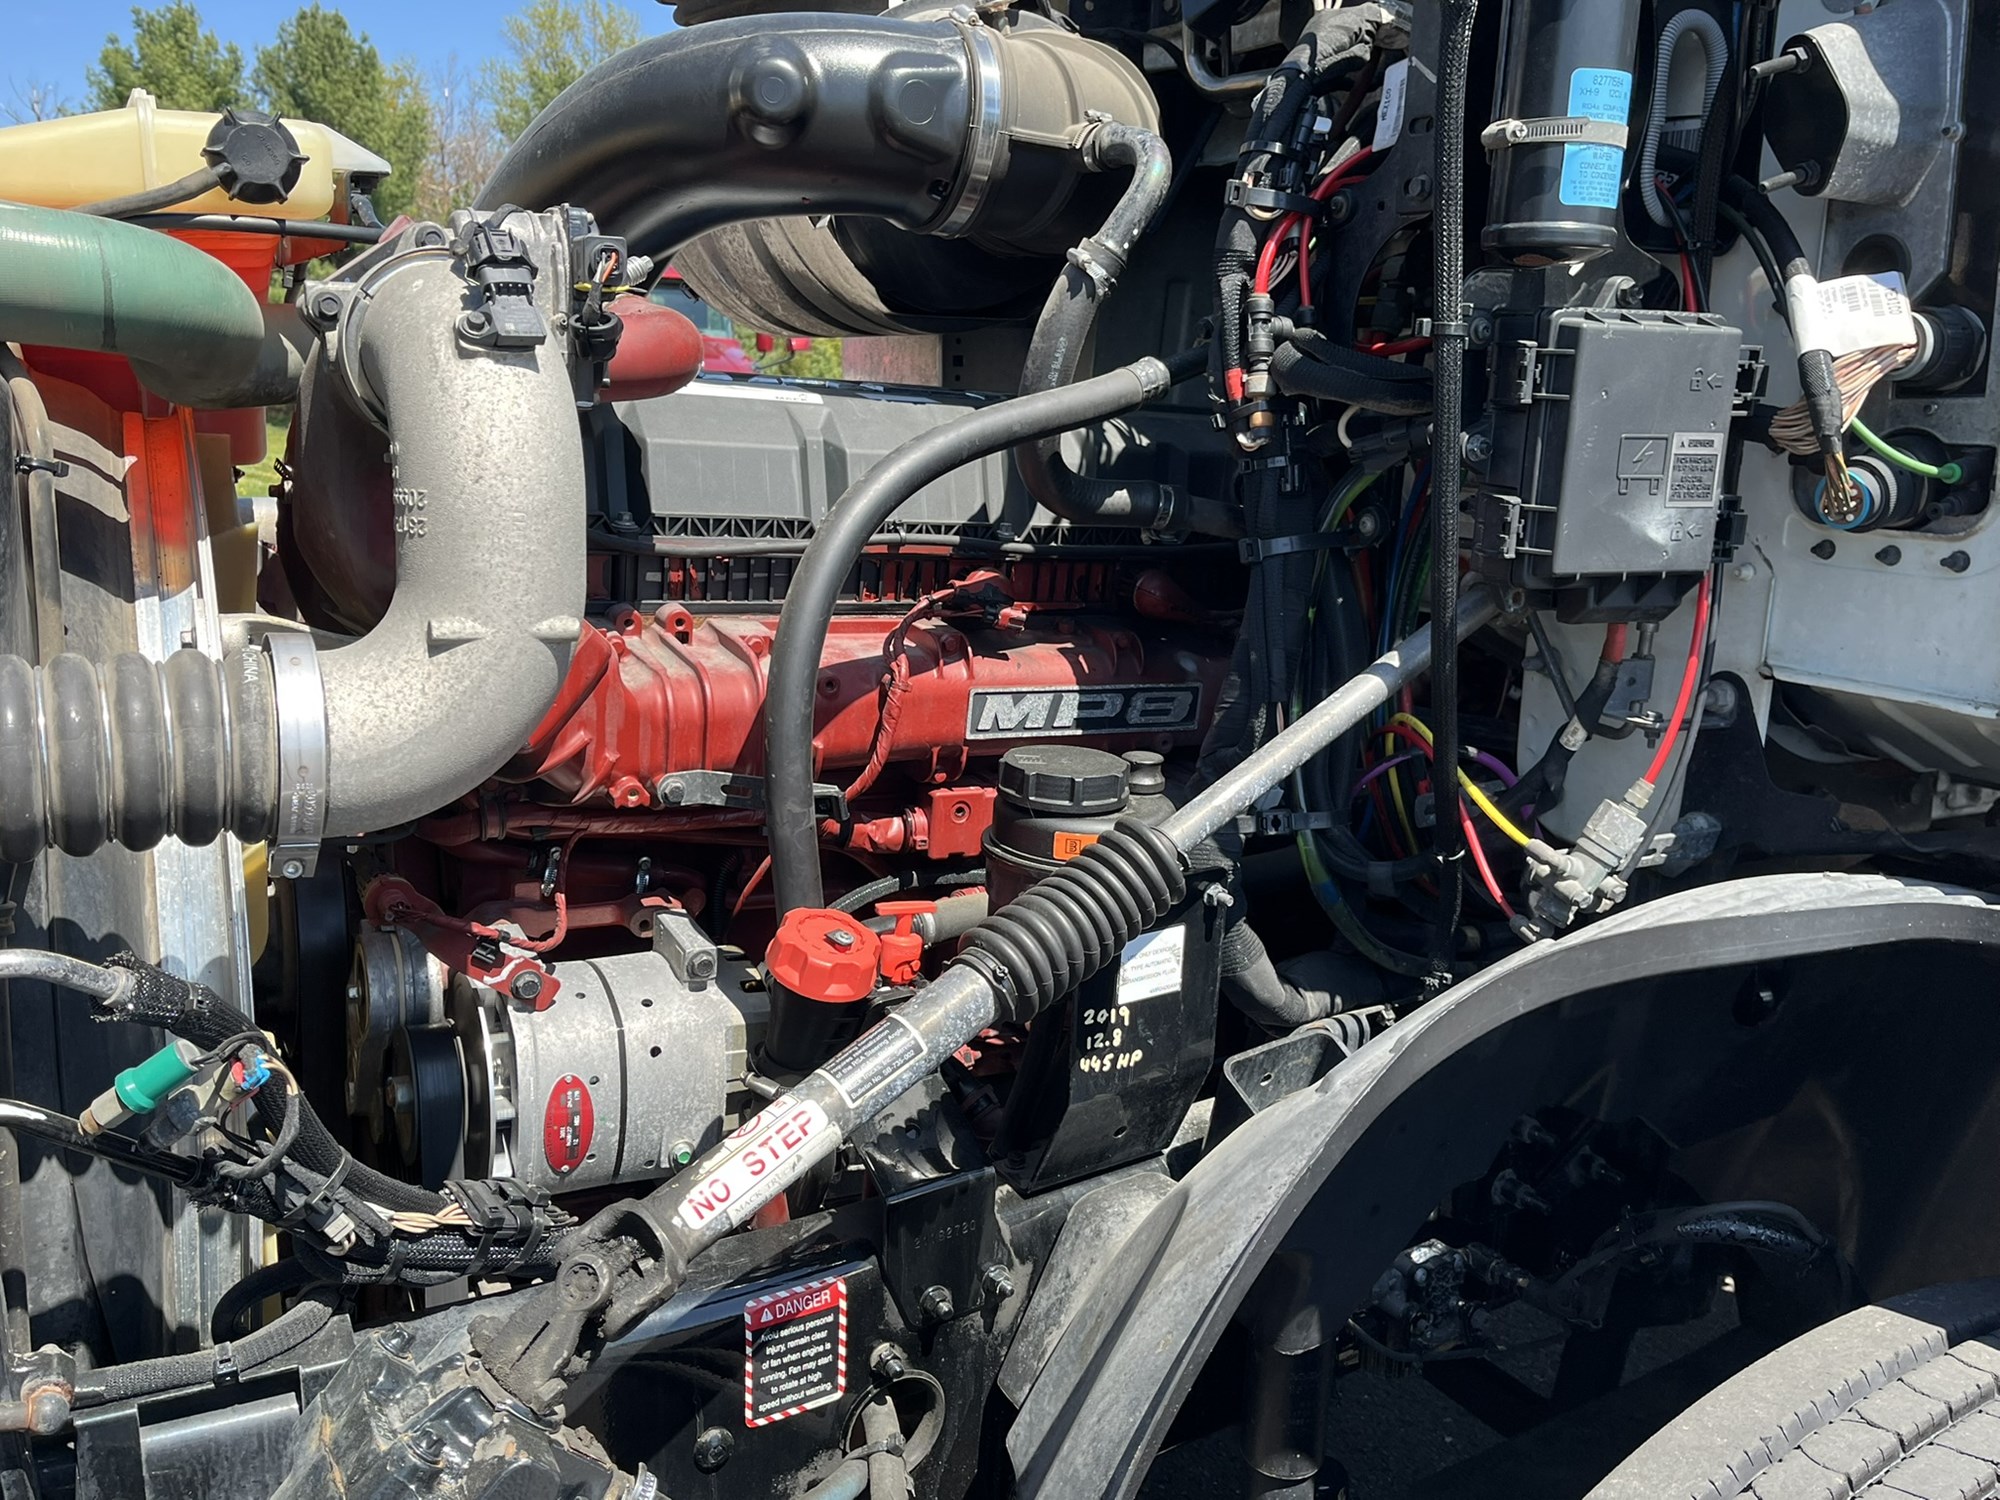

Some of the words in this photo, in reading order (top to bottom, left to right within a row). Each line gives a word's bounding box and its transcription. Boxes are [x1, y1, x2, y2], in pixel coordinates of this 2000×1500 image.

[1381, 88, 1392, 121] MEXICO
[1579, 170, 1588, 178] TO
[242, 651, 259, 683] CHINA
[976, 691, 1193, 732] MP8
[1083, 1005, 1130, 1026] 2019
[841, 1063, 852, 1074] the
[864, 1037, 889, 1058] Steering
[886, 1025, 904, 1041] Angle
[1086, 1028, 1122, 1050] 12.8
[1080, 1052, 1114, 1073] 445
[1116, 1049, 1143, 1070] HP
[849, 1080, 873, 1099] Bulletin
[871, 1073, 882, 1083] No.
[688, 1179, 731, 1220] NO
[742, 1110, 811, 1176] STEP
[731, 1187, 764, 1214] MACK
[776, 1290, 831, 1318] DANGER
[780, 1323, 804, 1337] serious
[805, 1313, 834, 1331] personal
[762, 1360, 769, 1370] of
[770, 1358, 781, 1367] fan
[782, 1352, 800, 1363] when
[801, 1344, 824, 1357] engine
[825, 1342, 831, 1350] is
[766, 1343, 786, 1355] injury,
[787, 1335, 810, 1348] remain
[811, 1330, 828, 1340] clear
[760, 1370, 787, 1384] running.
[788, 1365, 801, 1375] Fan
[802, 1360, 816, 1371] may
[818, 1354, 833, 1365] start
[770, 1386, 778, 1394] to
[779, 1379, 799, 1391] rotate
[800, 1377, 806, 1385] at
[808, 1371, 822, 1382] high
[758, 1398, 779, 1412] speed
[780, 1390, 805, 1404] without
[806, 1382, 832, 1396] warning.
